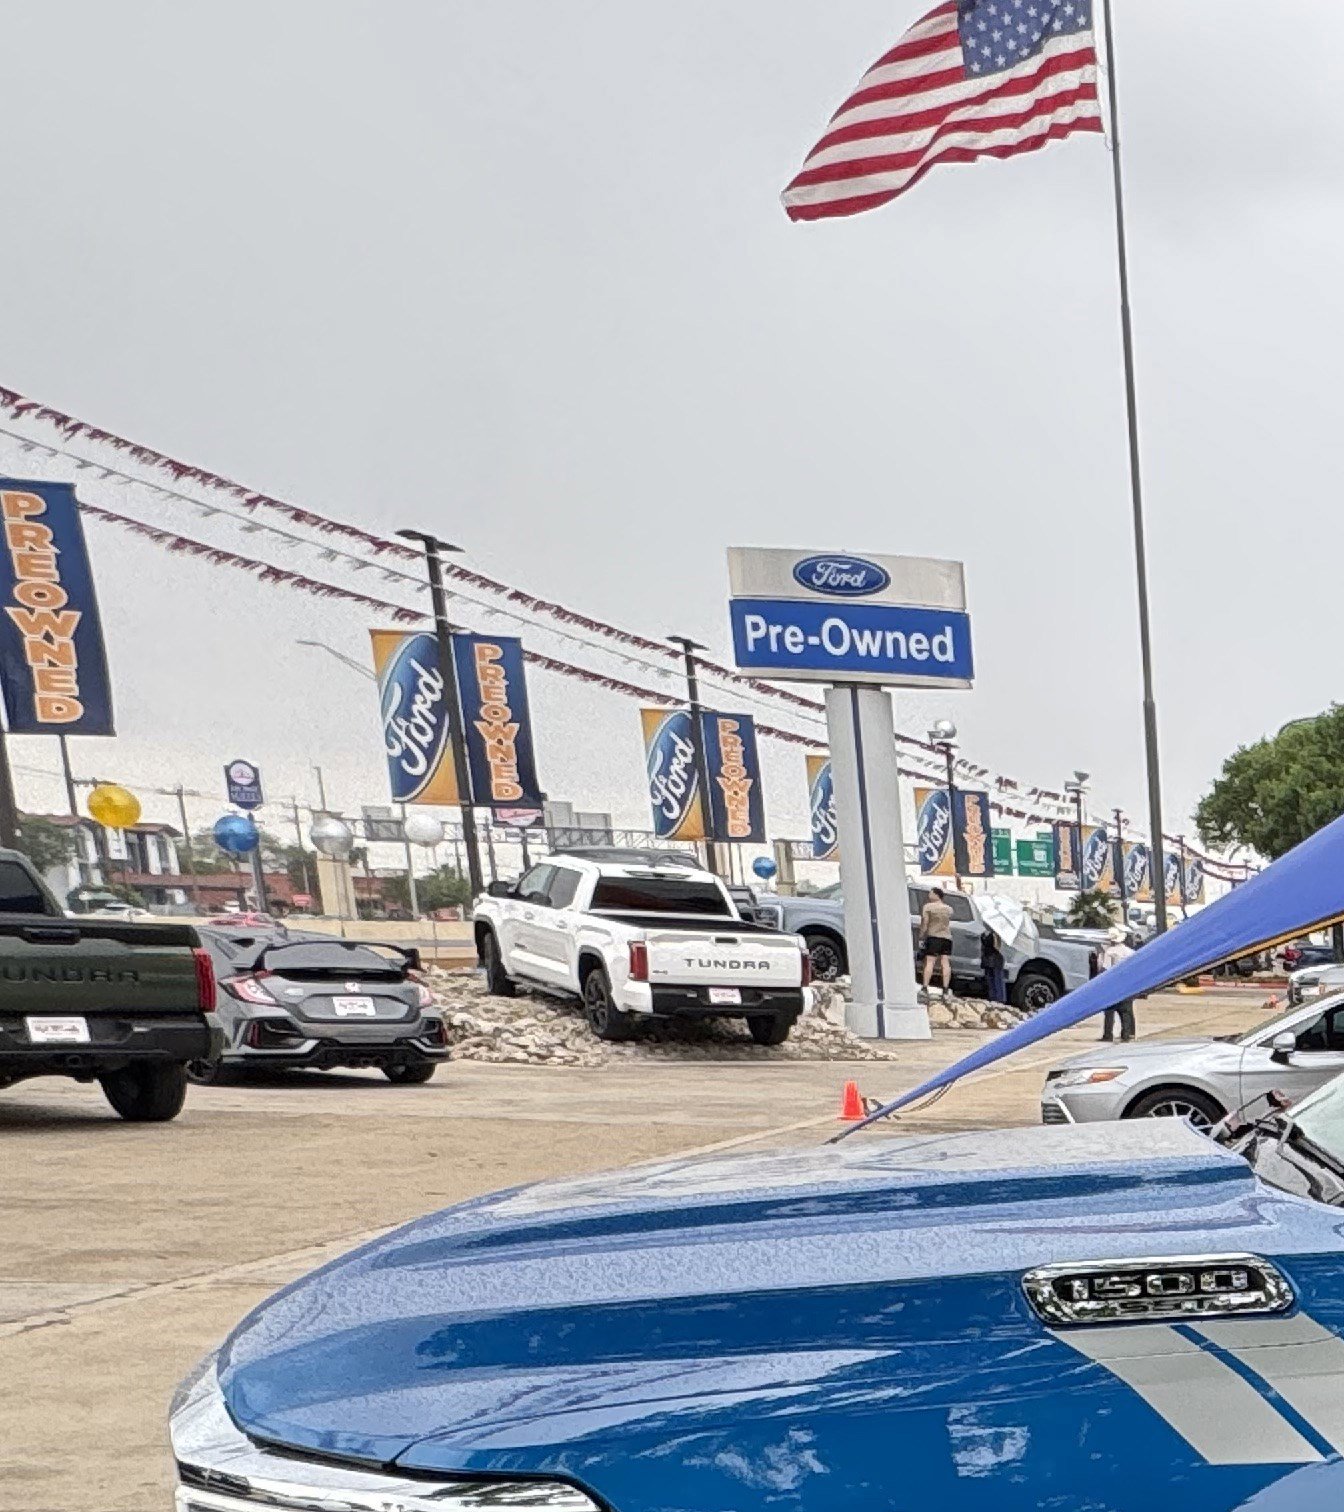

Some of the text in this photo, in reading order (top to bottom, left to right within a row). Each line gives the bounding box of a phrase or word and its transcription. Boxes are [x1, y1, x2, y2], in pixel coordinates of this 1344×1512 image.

[812, 561, 867, 588] Ford
[1, 490, 84, 723] PREOWNED
[745, 614, 956, 663] Pre-Owned
[385, 658, 445, 776] Ford
[473, 643, 524, 801] PREOWNED
[650, 731, 696, 820] Ford
[919, 802, 950, 862] Ford
[683, 958, 771, 971] TUNDRA
[1065, 1269, 1249, 1301] 1500
